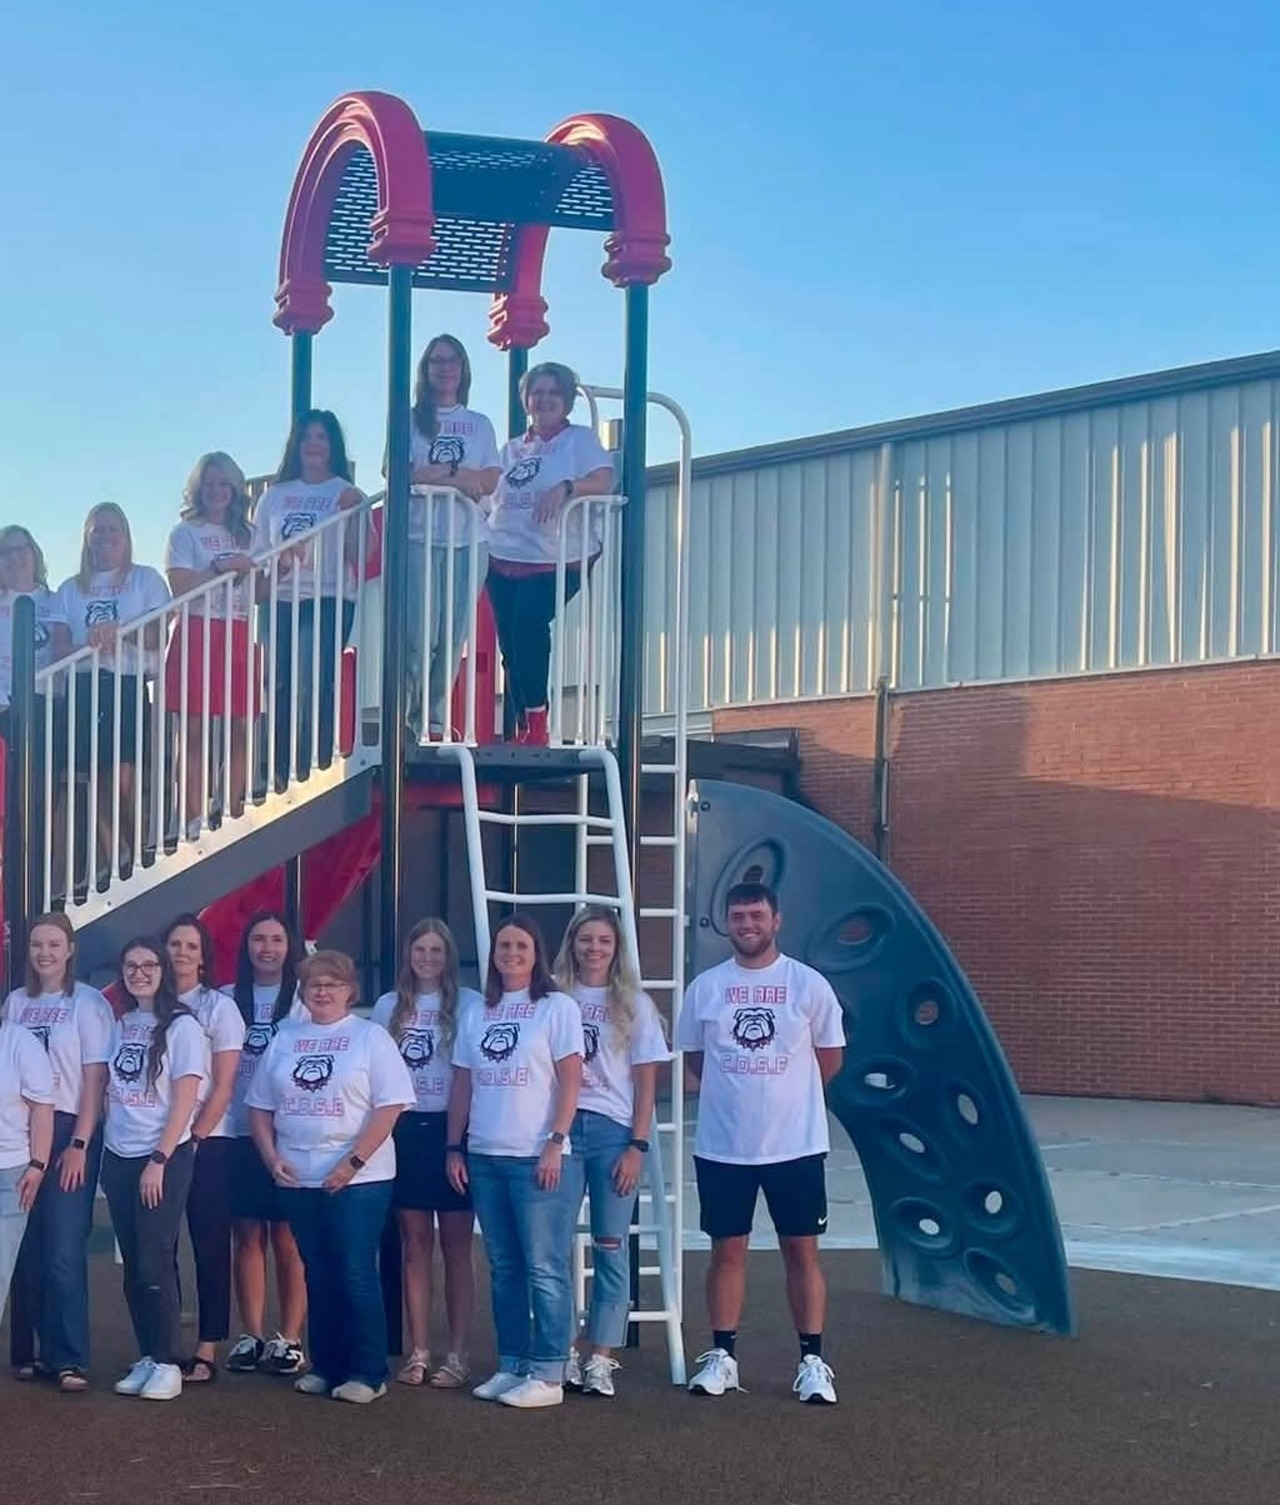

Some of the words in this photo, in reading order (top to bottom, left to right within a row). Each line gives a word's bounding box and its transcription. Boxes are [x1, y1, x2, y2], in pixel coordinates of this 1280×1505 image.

[725, 986, 749, 1004] WE
[753, 985, 787, 1004] ARE
[505, 1003, 536, 1020] ARE
[294, 1040, 317, 1053] WE
[318, 1037, 349, 1052] ARE
